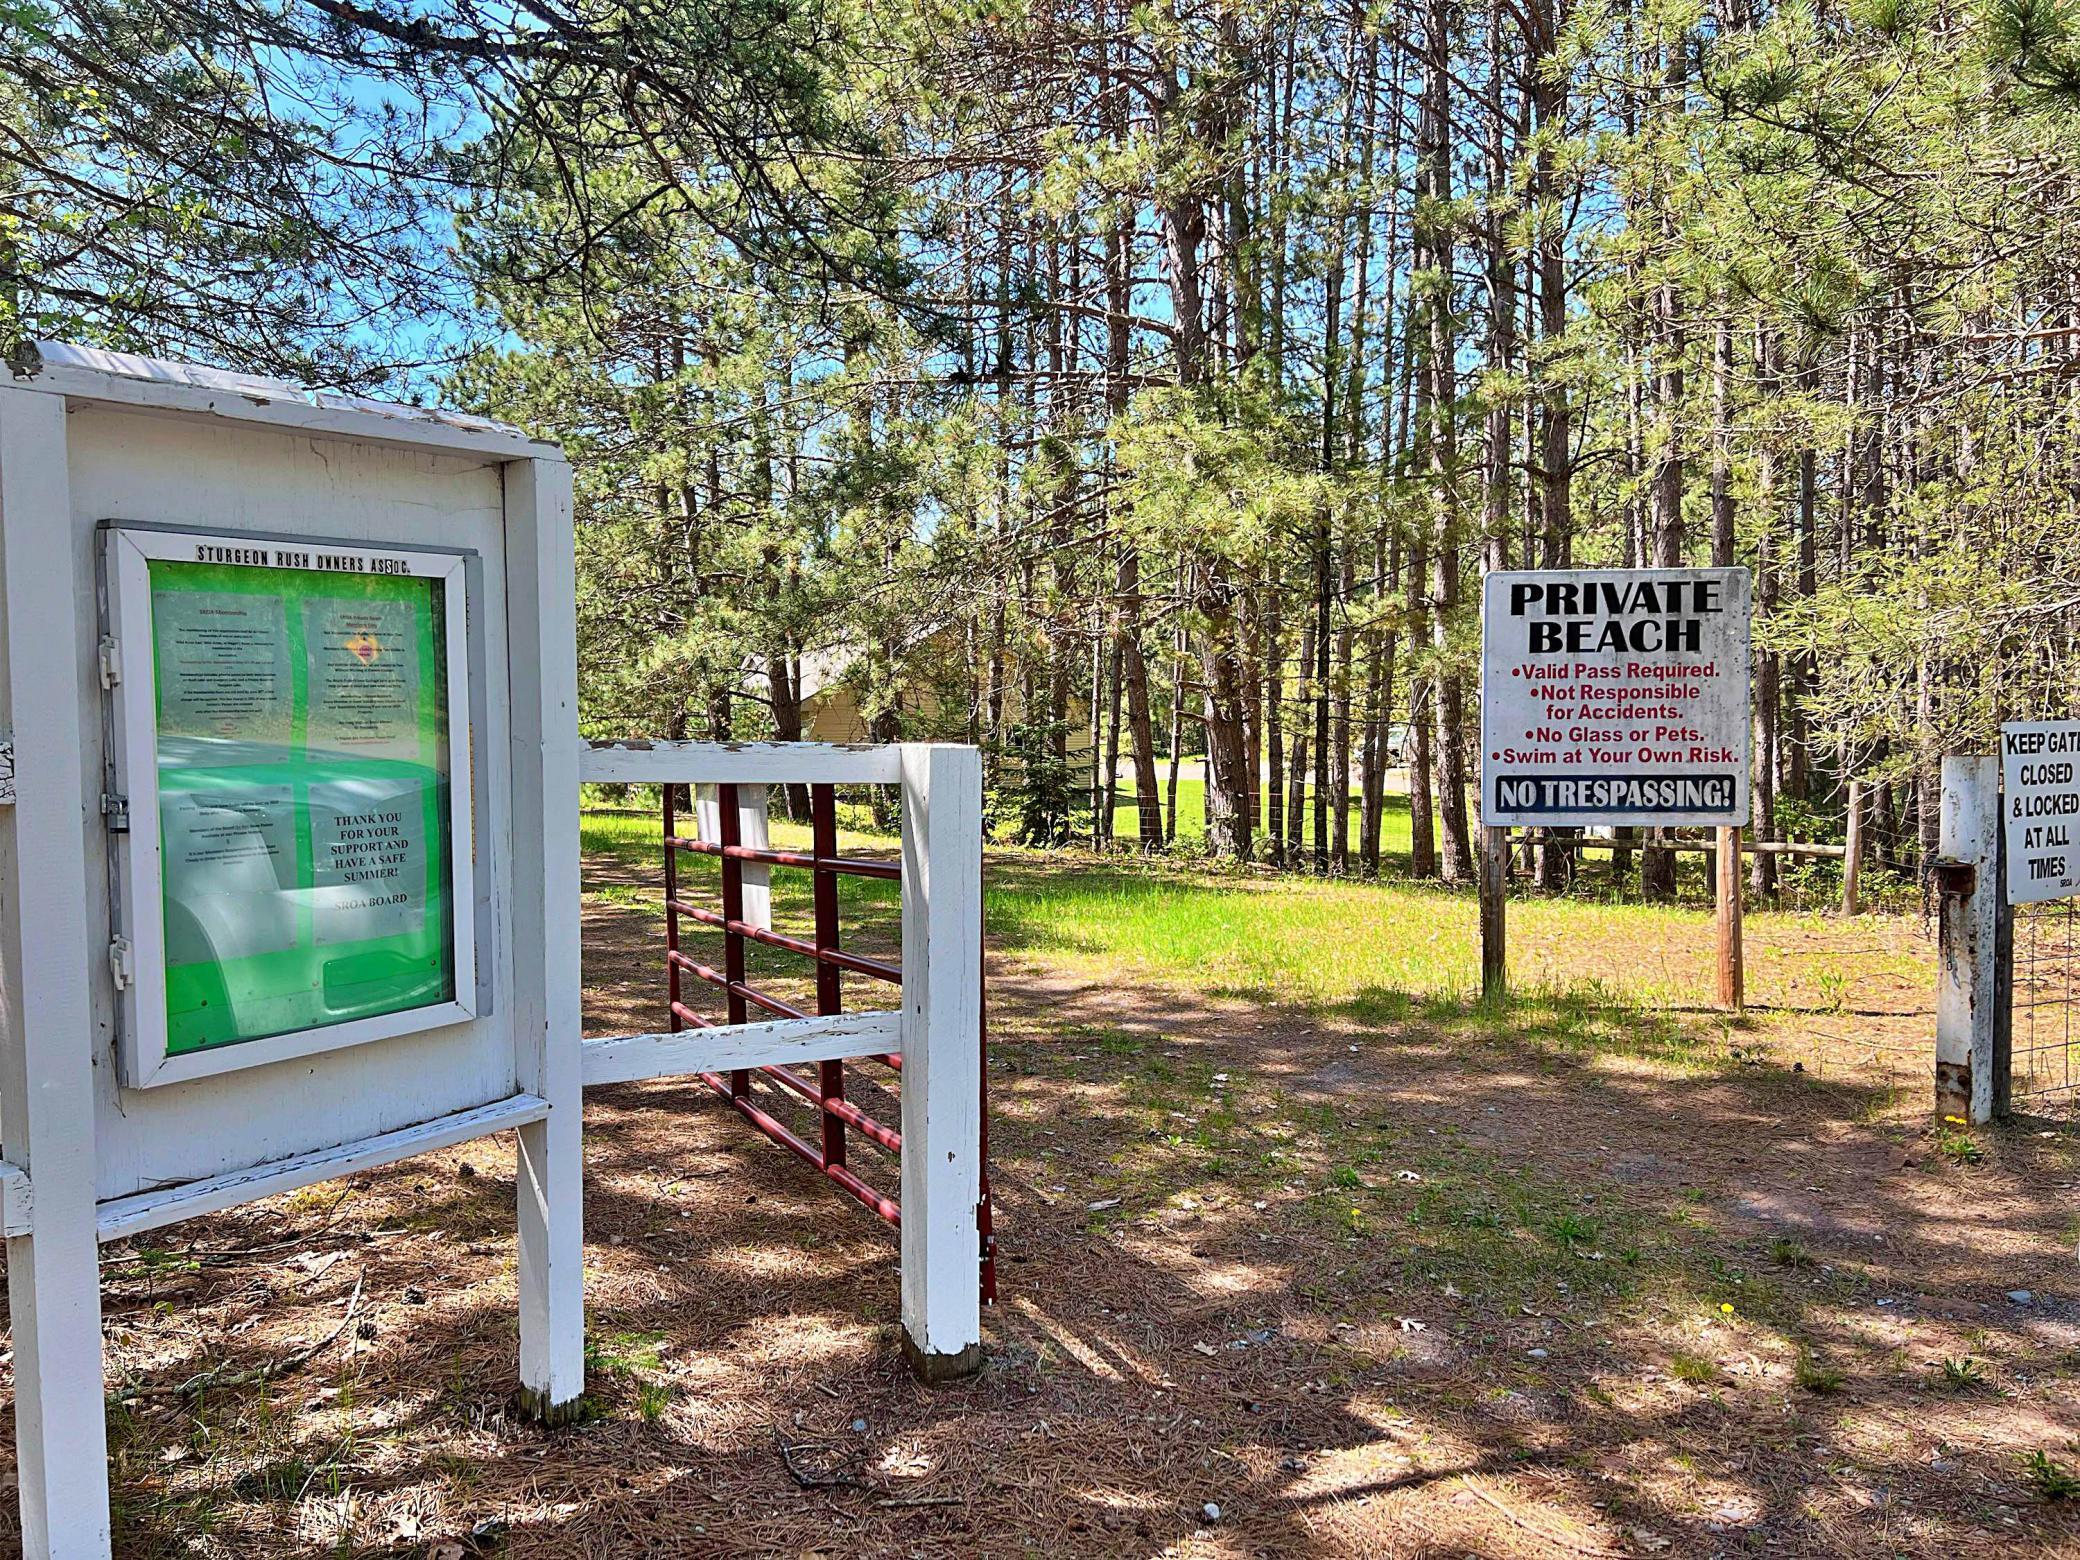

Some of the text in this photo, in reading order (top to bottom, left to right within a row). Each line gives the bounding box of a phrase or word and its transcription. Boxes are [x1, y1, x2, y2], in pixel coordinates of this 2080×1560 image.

[198, 546, 411, 574] STURGEON RUSH OWNERS ASSOC.
[1510, 580, 1723, 616] PRIVATE
[1529, 619, 1701, 654] BEACH
[1522, 661, 1720, 682] Valid Pass Required.
[1541, 683, 1700, 704] Not Responsible
[1546, 703, 1683, 720] for Accidents.
[1536, 726, 1705, 743] No Glass or Pets.
[2006, 732, 2046, 755] KEEP
[1503, 747, 1739, 764] Swim at Your Own Risk.
[2020, 763, 2073, 786] CLOSED
[1500, 778, 1732, 808] NO TRESPASSING!
[2013, 793, 2079, 818] & LOCKED
[334, 812, 402, 827] THANK YOU
[340, 826, 399, 840] FOR YOUR
[2024, 825, 2070, 849] AT ALL
[331, 839, 409, 856] SUPPORT AND
[335, 853, 407, 869] HAVE A SAFE
[2028, 856, 2066, 880] TIMES
[344, 867, 399, 882] SUMMER!
[367, 893, 408, 907] BOARD
